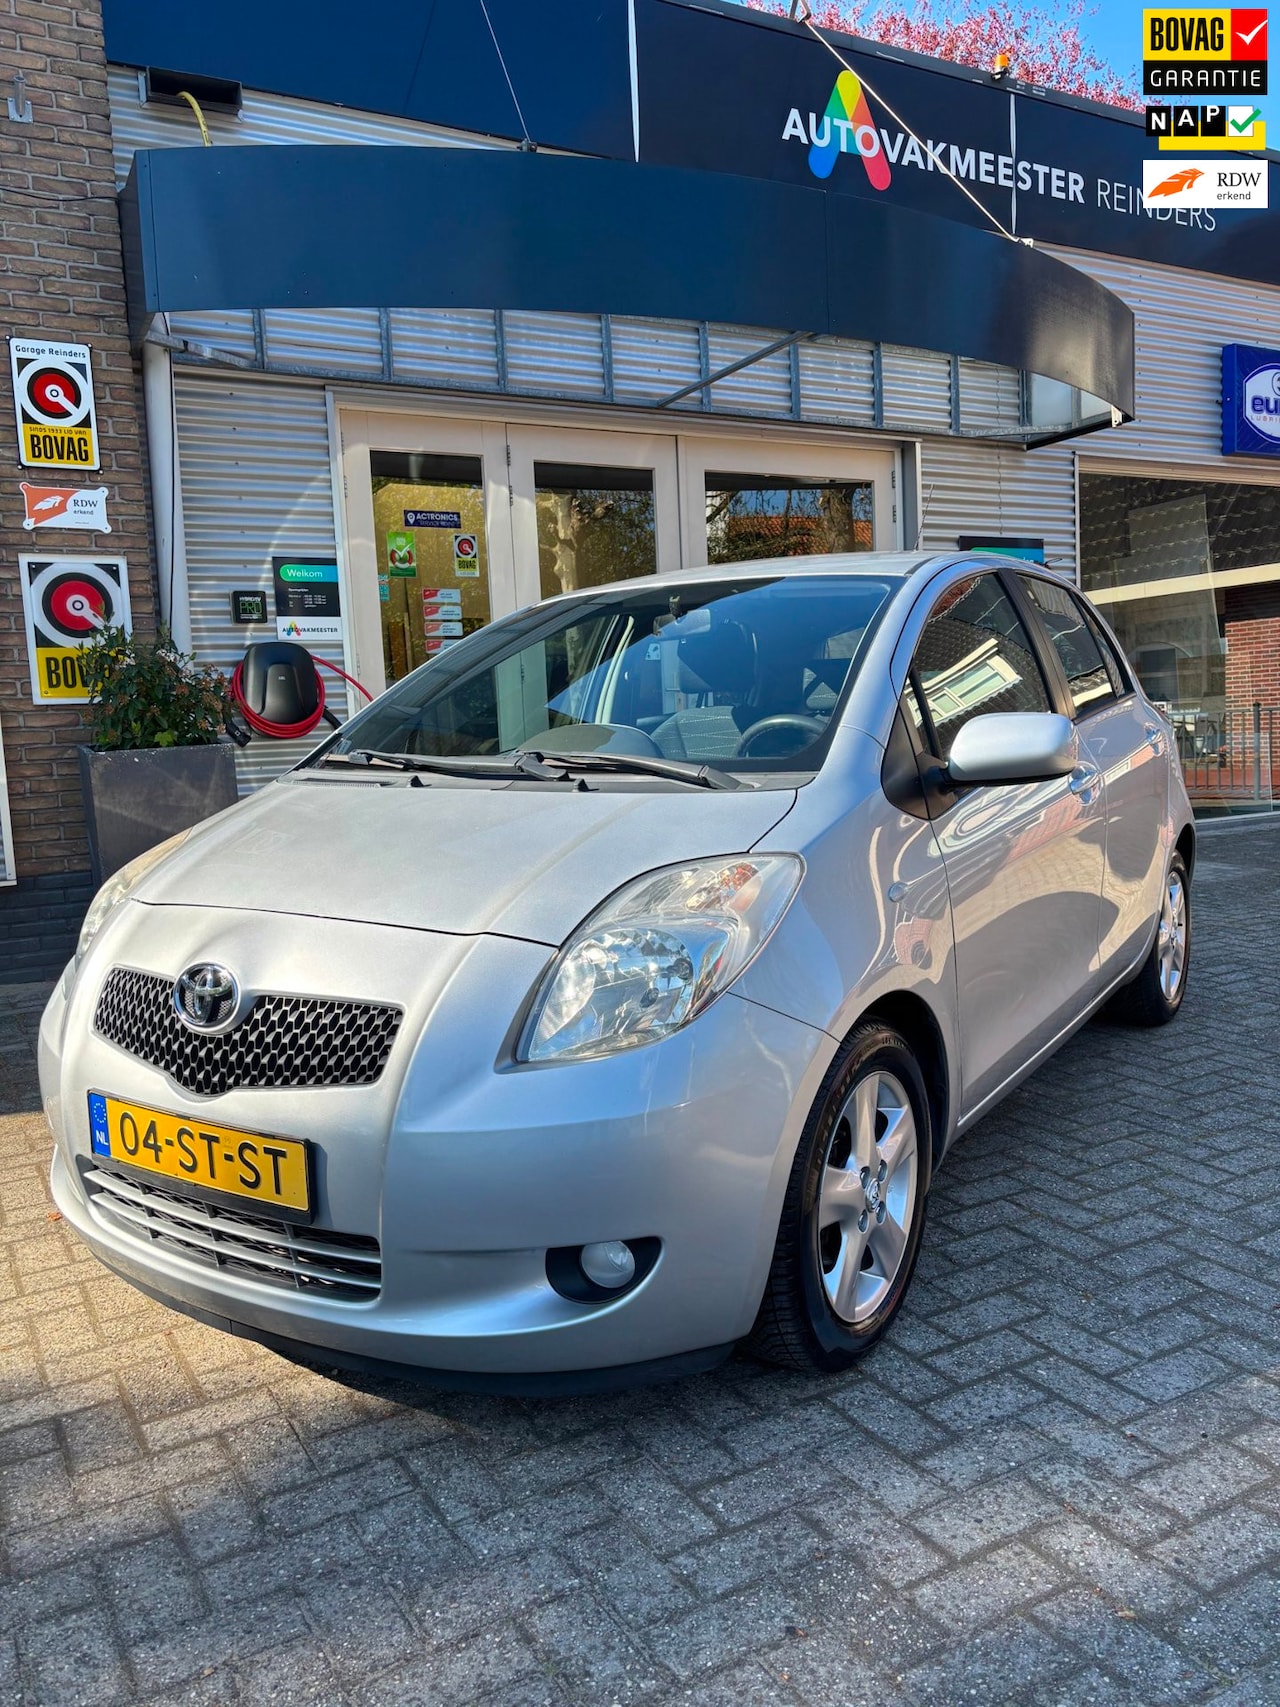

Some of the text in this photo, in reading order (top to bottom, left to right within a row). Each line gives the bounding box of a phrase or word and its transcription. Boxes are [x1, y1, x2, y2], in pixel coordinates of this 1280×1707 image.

[781, 107, 1085, 204] AUTOVAKMEESTER
[15, 345, 86, 358] Garage Reinders
[1251, 394, 1280, 415] eu
[30, 434, 89, 462] BOVAG
[73, 499, 98, 508] RDW
[416, 512, 458, 521] ACTRONICS
[287, 568, 323, 578] Welkom
[458, 560, 476, 569] BOVAG
[45, 655, 111, 689] BOV
[96, 1129, 109, 1146] NL
[119, 1111, 287, 1196] 04-ST-ST
